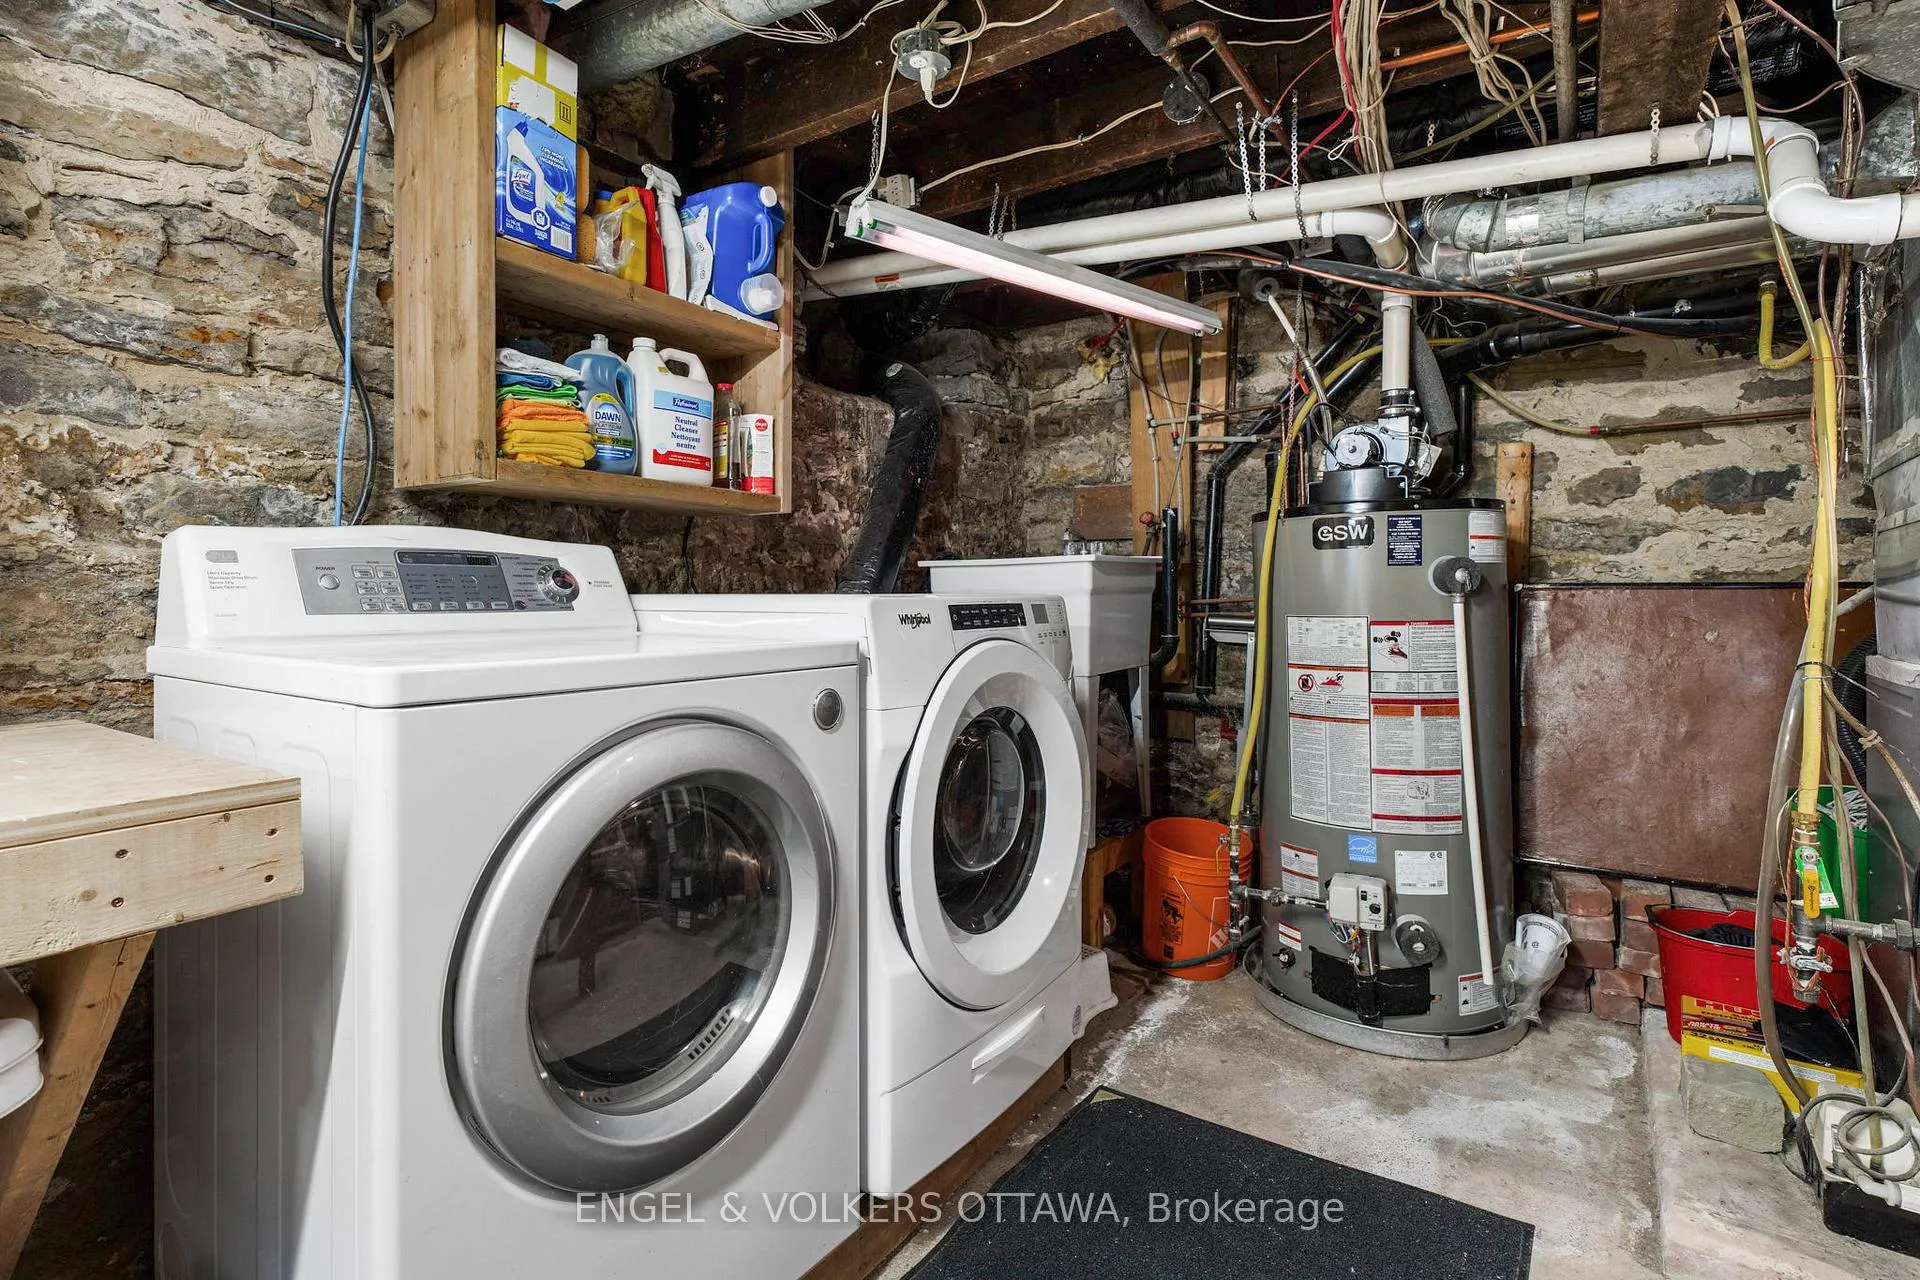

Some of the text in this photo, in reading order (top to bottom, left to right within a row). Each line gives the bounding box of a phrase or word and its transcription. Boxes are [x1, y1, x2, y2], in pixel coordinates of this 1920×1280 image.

[594, 410, 622, 423] DAWN
[675, 415, 698, 426] Neutral
[674, 423, 698, 434] Cleaner
[676, 442, 696, 450] neutre
[1317, 524, 1368, 541] GSW
[898, 612, 931, 629] Whirlpool
